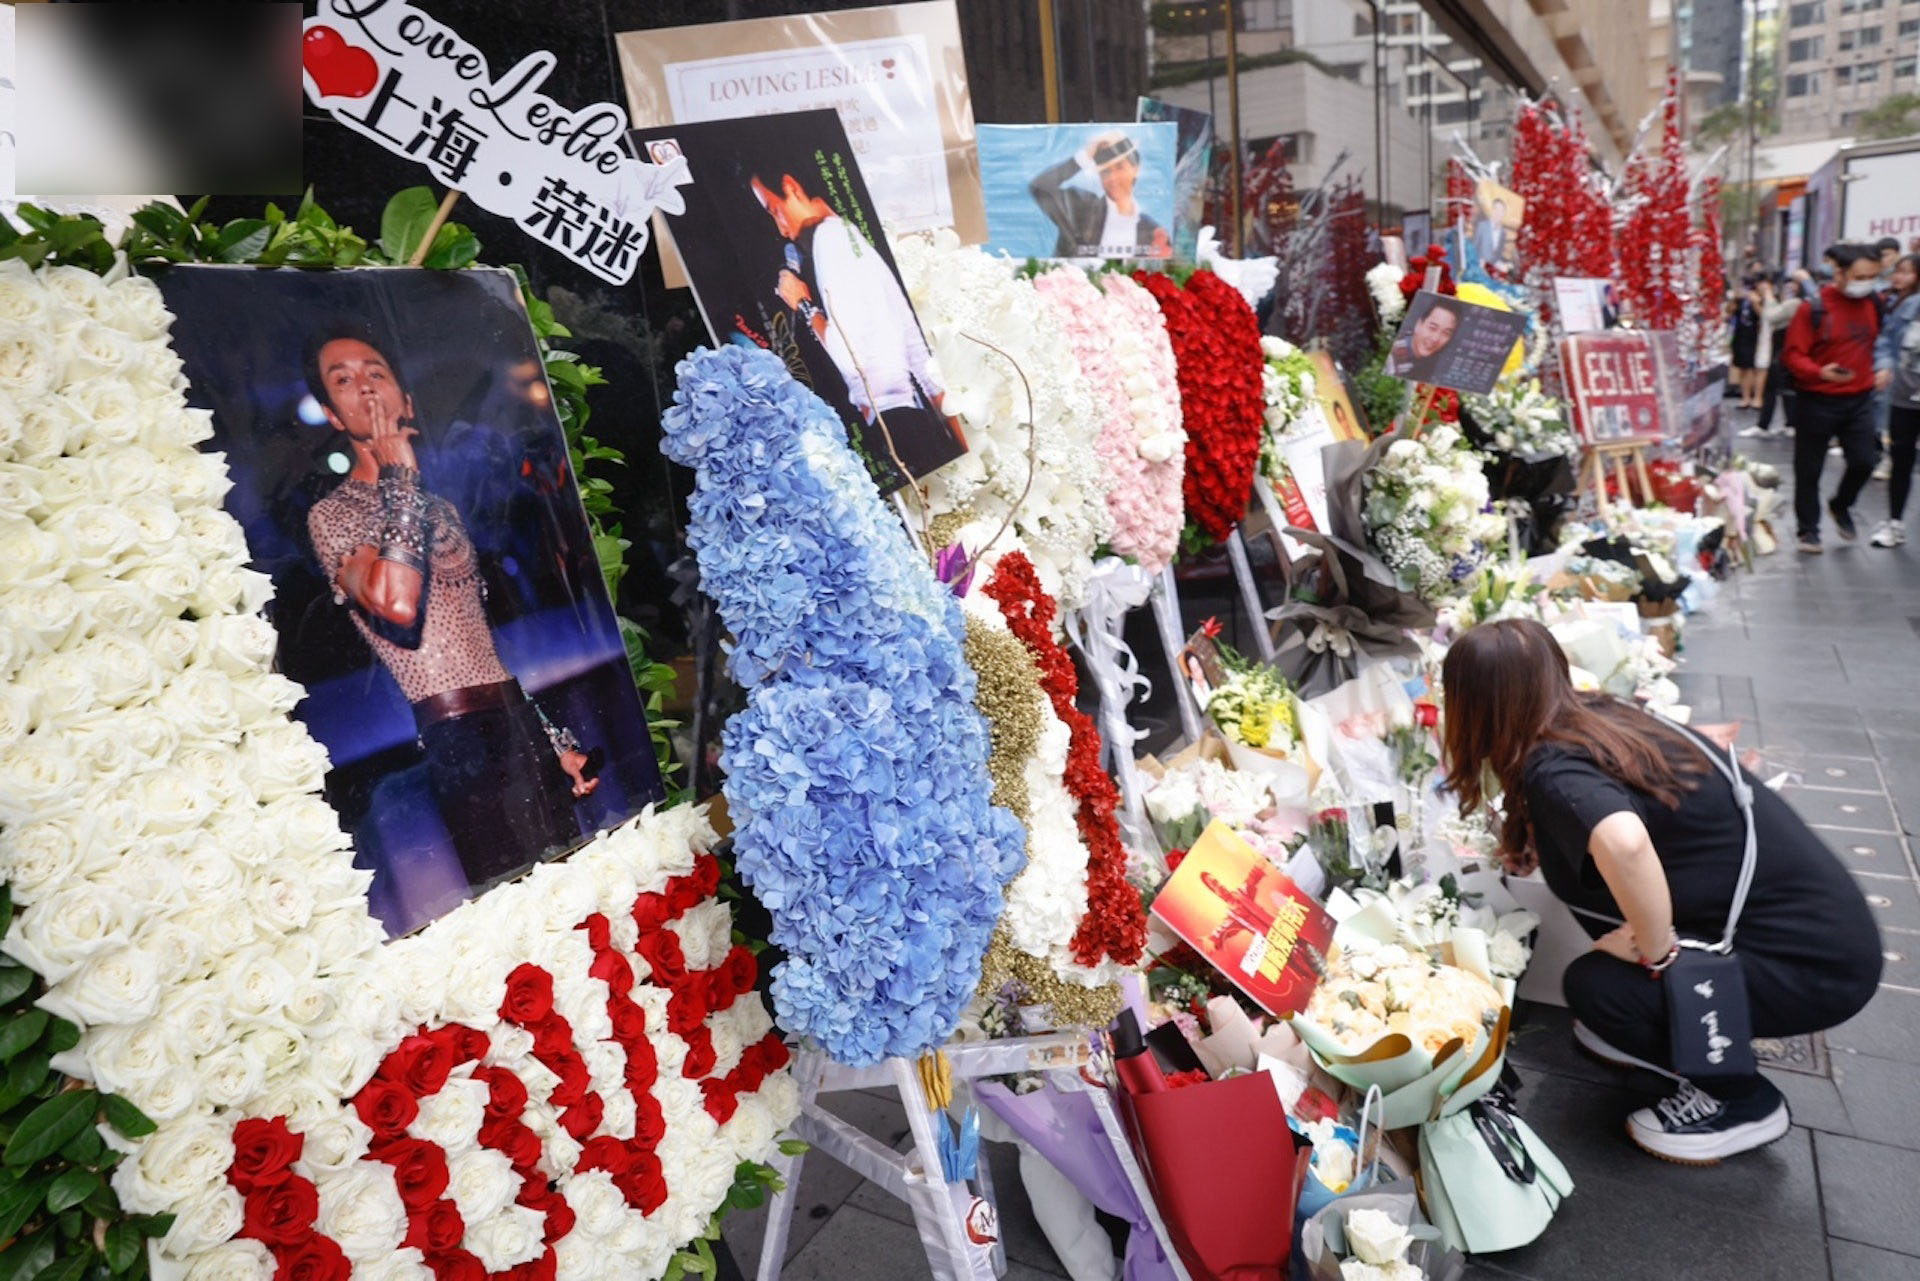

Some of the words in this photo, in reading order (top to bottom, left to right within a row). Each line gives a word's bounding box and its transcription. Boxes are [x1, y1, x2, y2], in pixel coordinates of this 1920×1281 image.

[332, 0, 483, 80] Love
[469, 60, 620, 175] Leslie
[709, 72, 797, 102] LOVING
[1868, 213, 1920, 237] HUT
